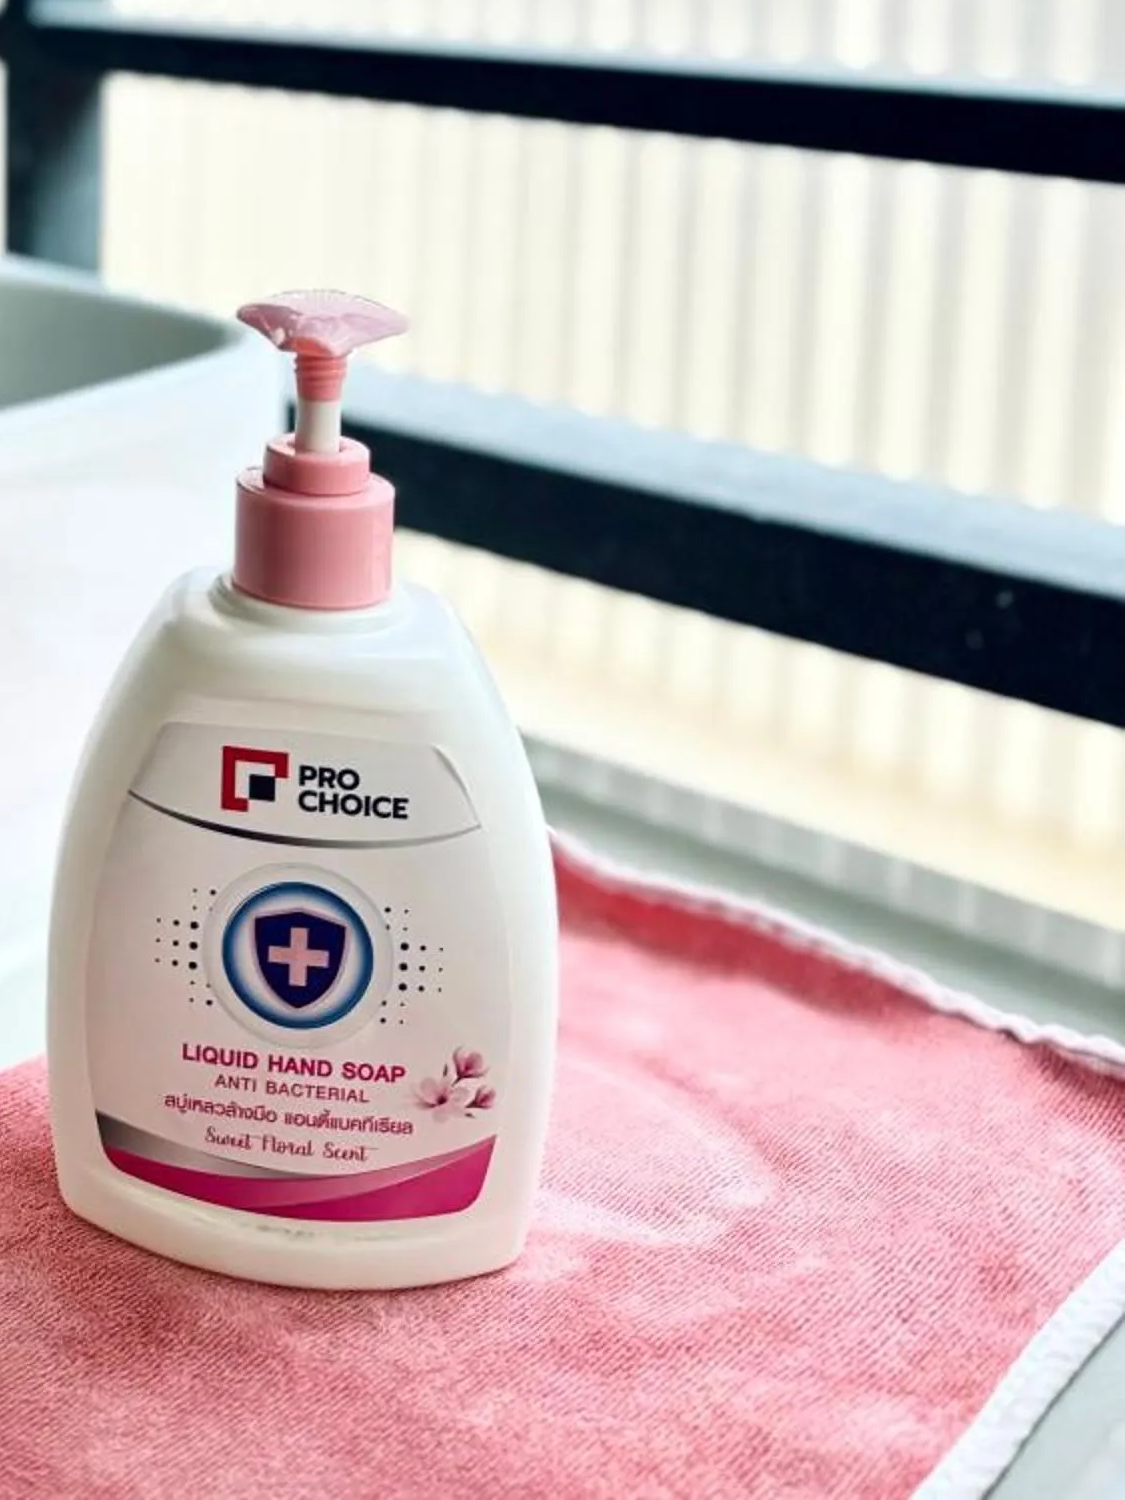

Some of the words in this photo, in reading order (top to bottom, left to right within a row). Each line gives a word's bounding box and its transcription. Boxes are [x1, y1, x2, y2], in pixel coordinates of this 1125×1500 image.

[298, 765, 360, 790] PRO
[297, 791, 409, 819] CHOICE
[182, 1043, 258, 1070] LIQUID
[267, 1055, 333, 1078] HAND
[342, 1062, 406, 1083] SOAP
[214, 1074, 258, 1093] ANTI
[265, 1081, 370, 1103] BACTERIAL
[204, 1126, 259, 1150] Sweet
[261, 1134, 313, 1157] Floral
[322, 1141, 375, 1162] Scent
